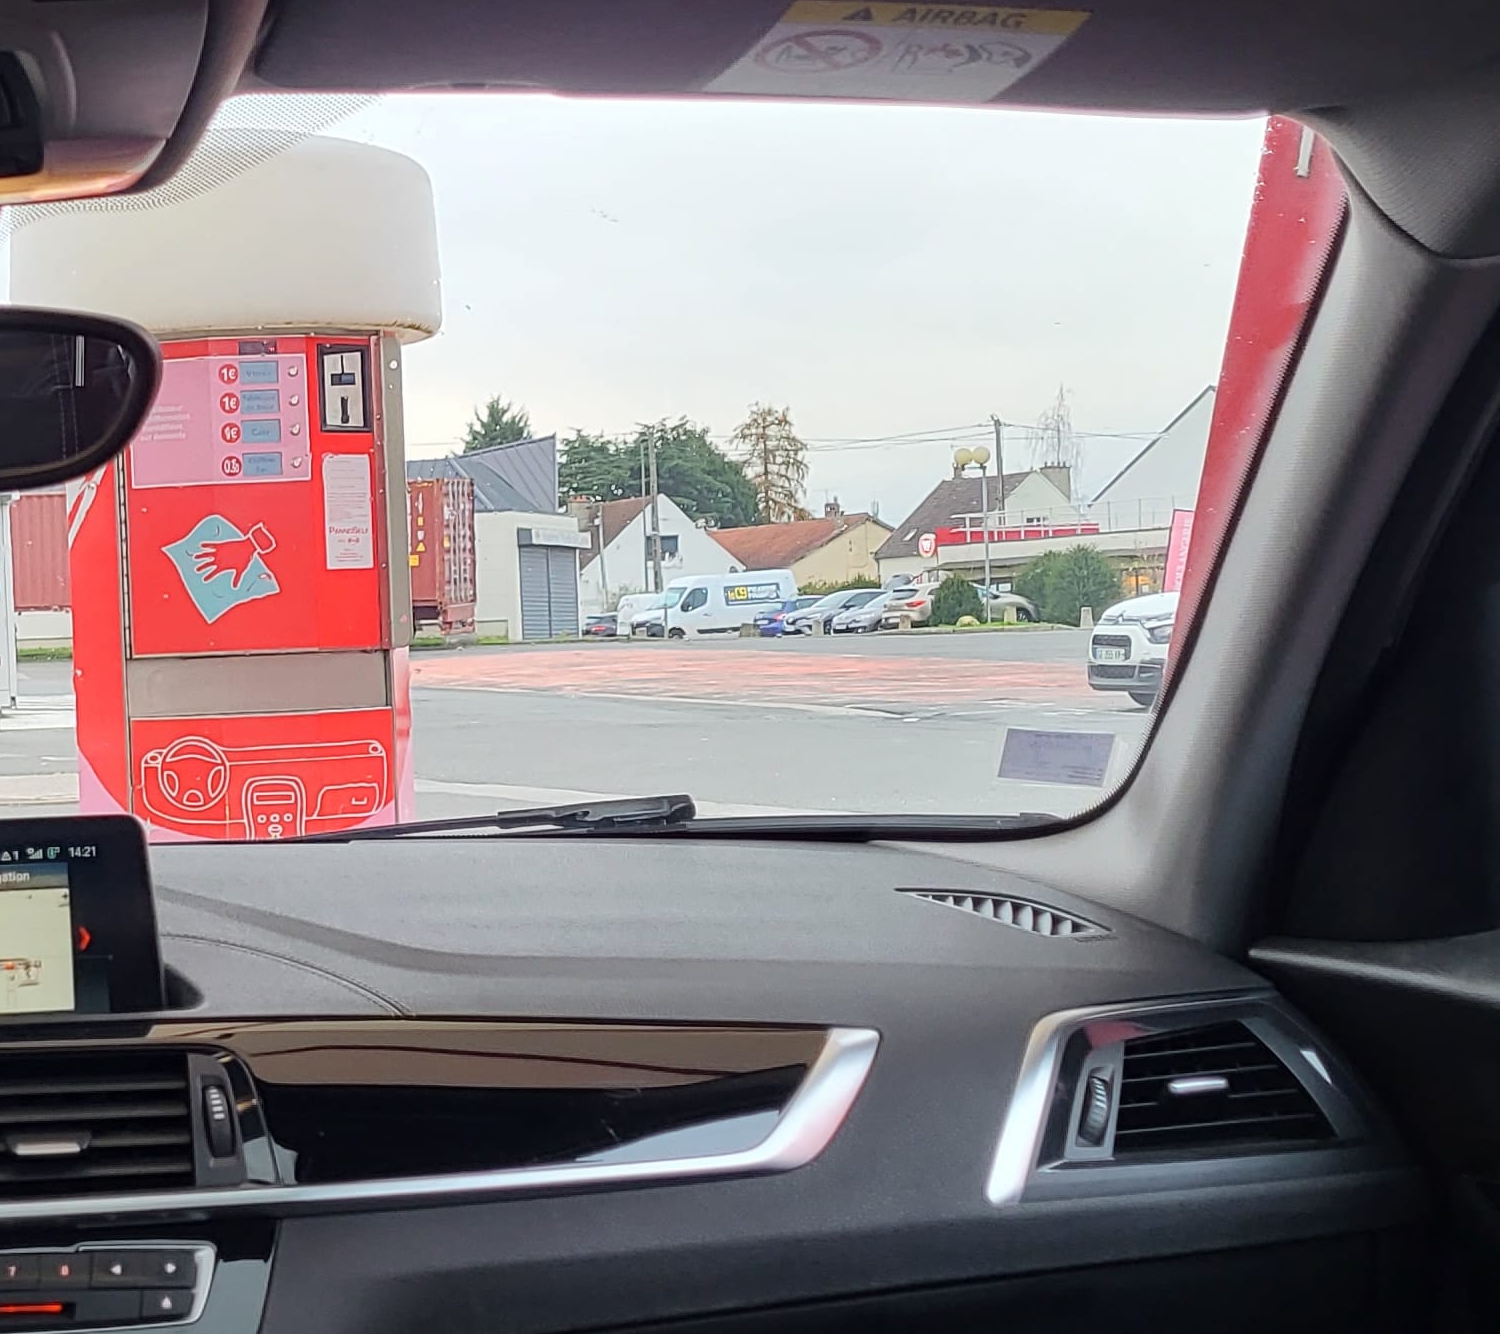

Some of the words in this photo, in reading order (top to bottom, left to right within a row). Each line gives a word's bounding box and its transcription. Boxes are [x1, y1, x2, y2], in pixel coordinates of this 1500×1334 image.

[892, 7, 1028, 29] AIRBAG
[221, 368, 236, 381] 1€
[223, 397, 237, 410] 1€
[68, 846, 97, 858] 14:21
